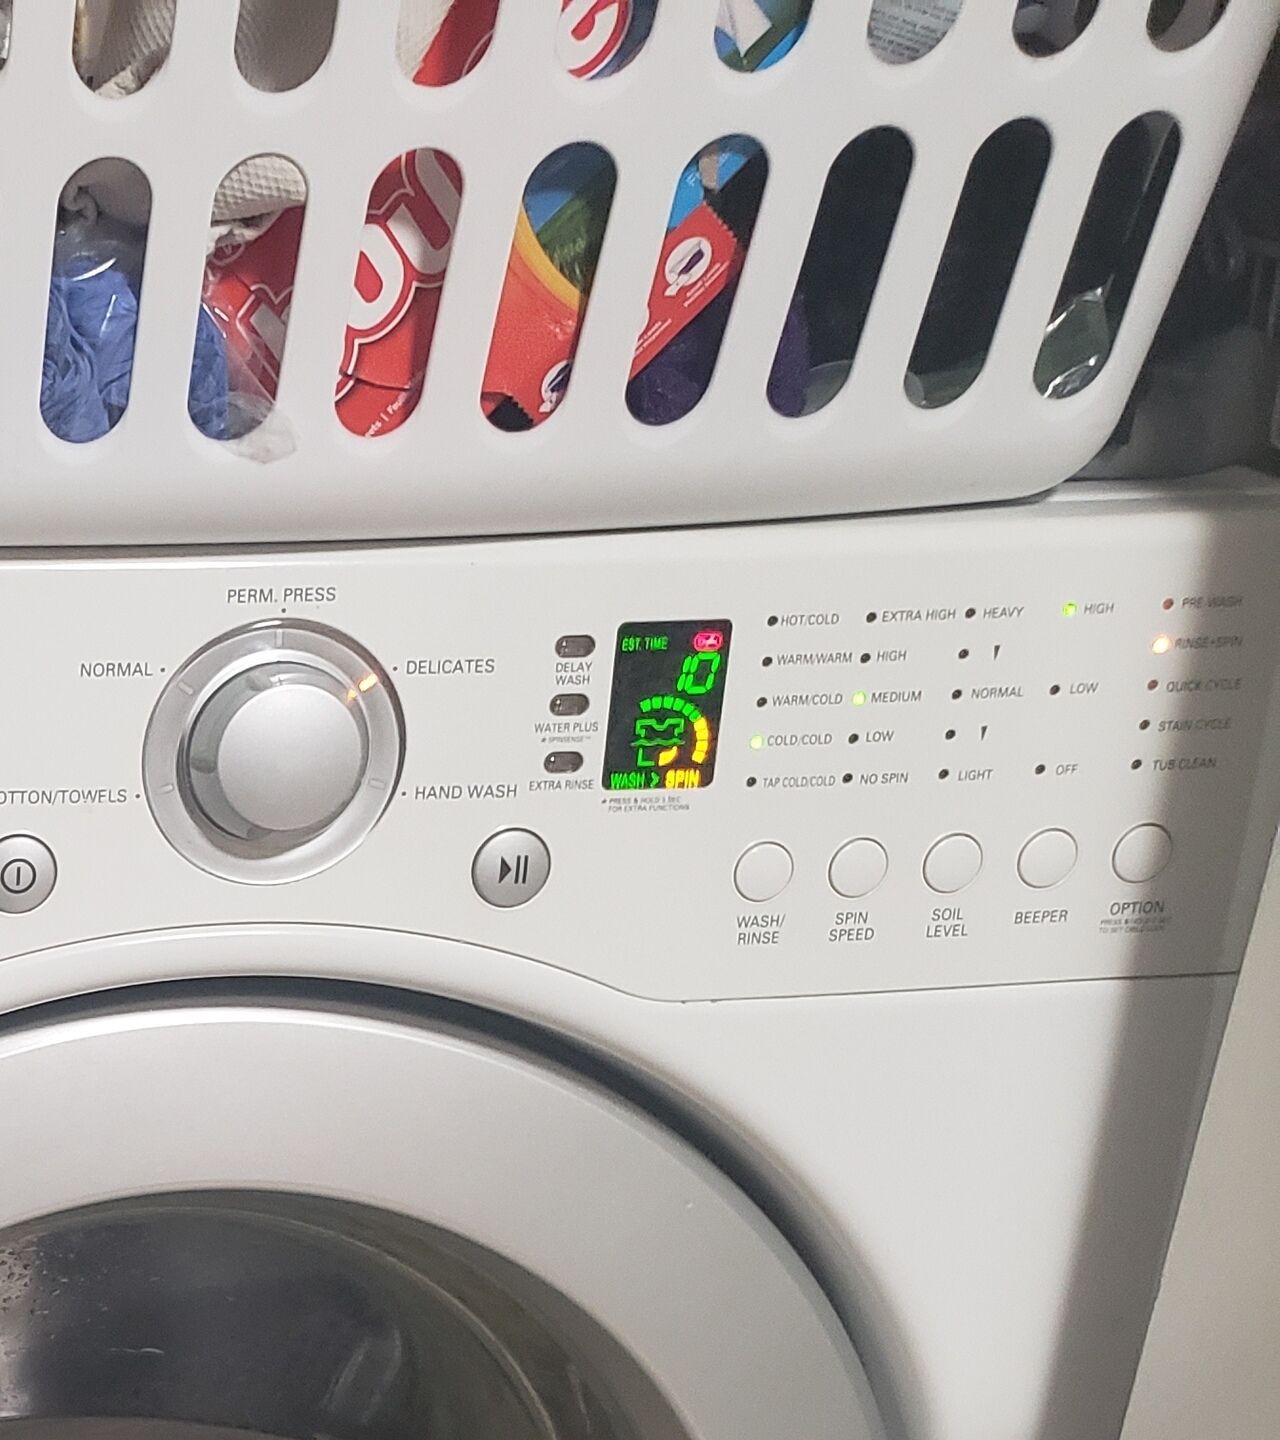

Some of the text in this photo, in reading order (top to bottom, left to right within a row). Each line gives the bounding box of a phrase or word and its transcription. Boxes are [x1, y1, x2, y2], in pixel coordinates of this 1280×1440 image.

[227, 587, 337, 604] PERM. PRESS
[983, 606, 1024, 619] HEAVY
[1083, 603, 1115, 614] HIGH
[882, 609, 956, 622] EXTRA HIGH
[645, 636, 669, 650] TIME
[777, 653, 853, 666] WARM/WARM
[876, 650, 907, 662] HIGH
[80, 662, 154, 678] NORMAL
[405, 659, 495, 675] DELICATES
[556, 662, 593, 673] DELAY
[555, 675, 591, 686] WASH
[971, 687, 1024, 700] NORMAL
[1069, 682, 1099, 694] LOW
[772, 694, 843, 707] WARM/COLD
[871, 690, 922, 703] MEDIUM
[534, 721, 599, 734] WATER PLUS
[865, 730, 894, 743] LOW
[958, 769, 993, 781] LIGHT
[1056, 764, 1079, 775] OFF
[529, 779, 594, 791] EXTRA RINSE
[611, 768, 700, 790] WASH SPIN
[763, 777, 780, 789] TAP
[860, 772, 909, 785] NO SPIN
[415, 783, 518, 800] HAND WASH
[932, 907, 964, 921] SOIL
[1110, 901, 1165, 916] OPTION
[736, 913, 786, 929] WASH/
[835, 911, 869, 925] SPIN
[1014, 909, 1068, 925] BEEPER
[737, 931, 780, 945] RINSE
[828, 927, 875, 942] SPEED
[926, 924, 969, 939] LEVEL
